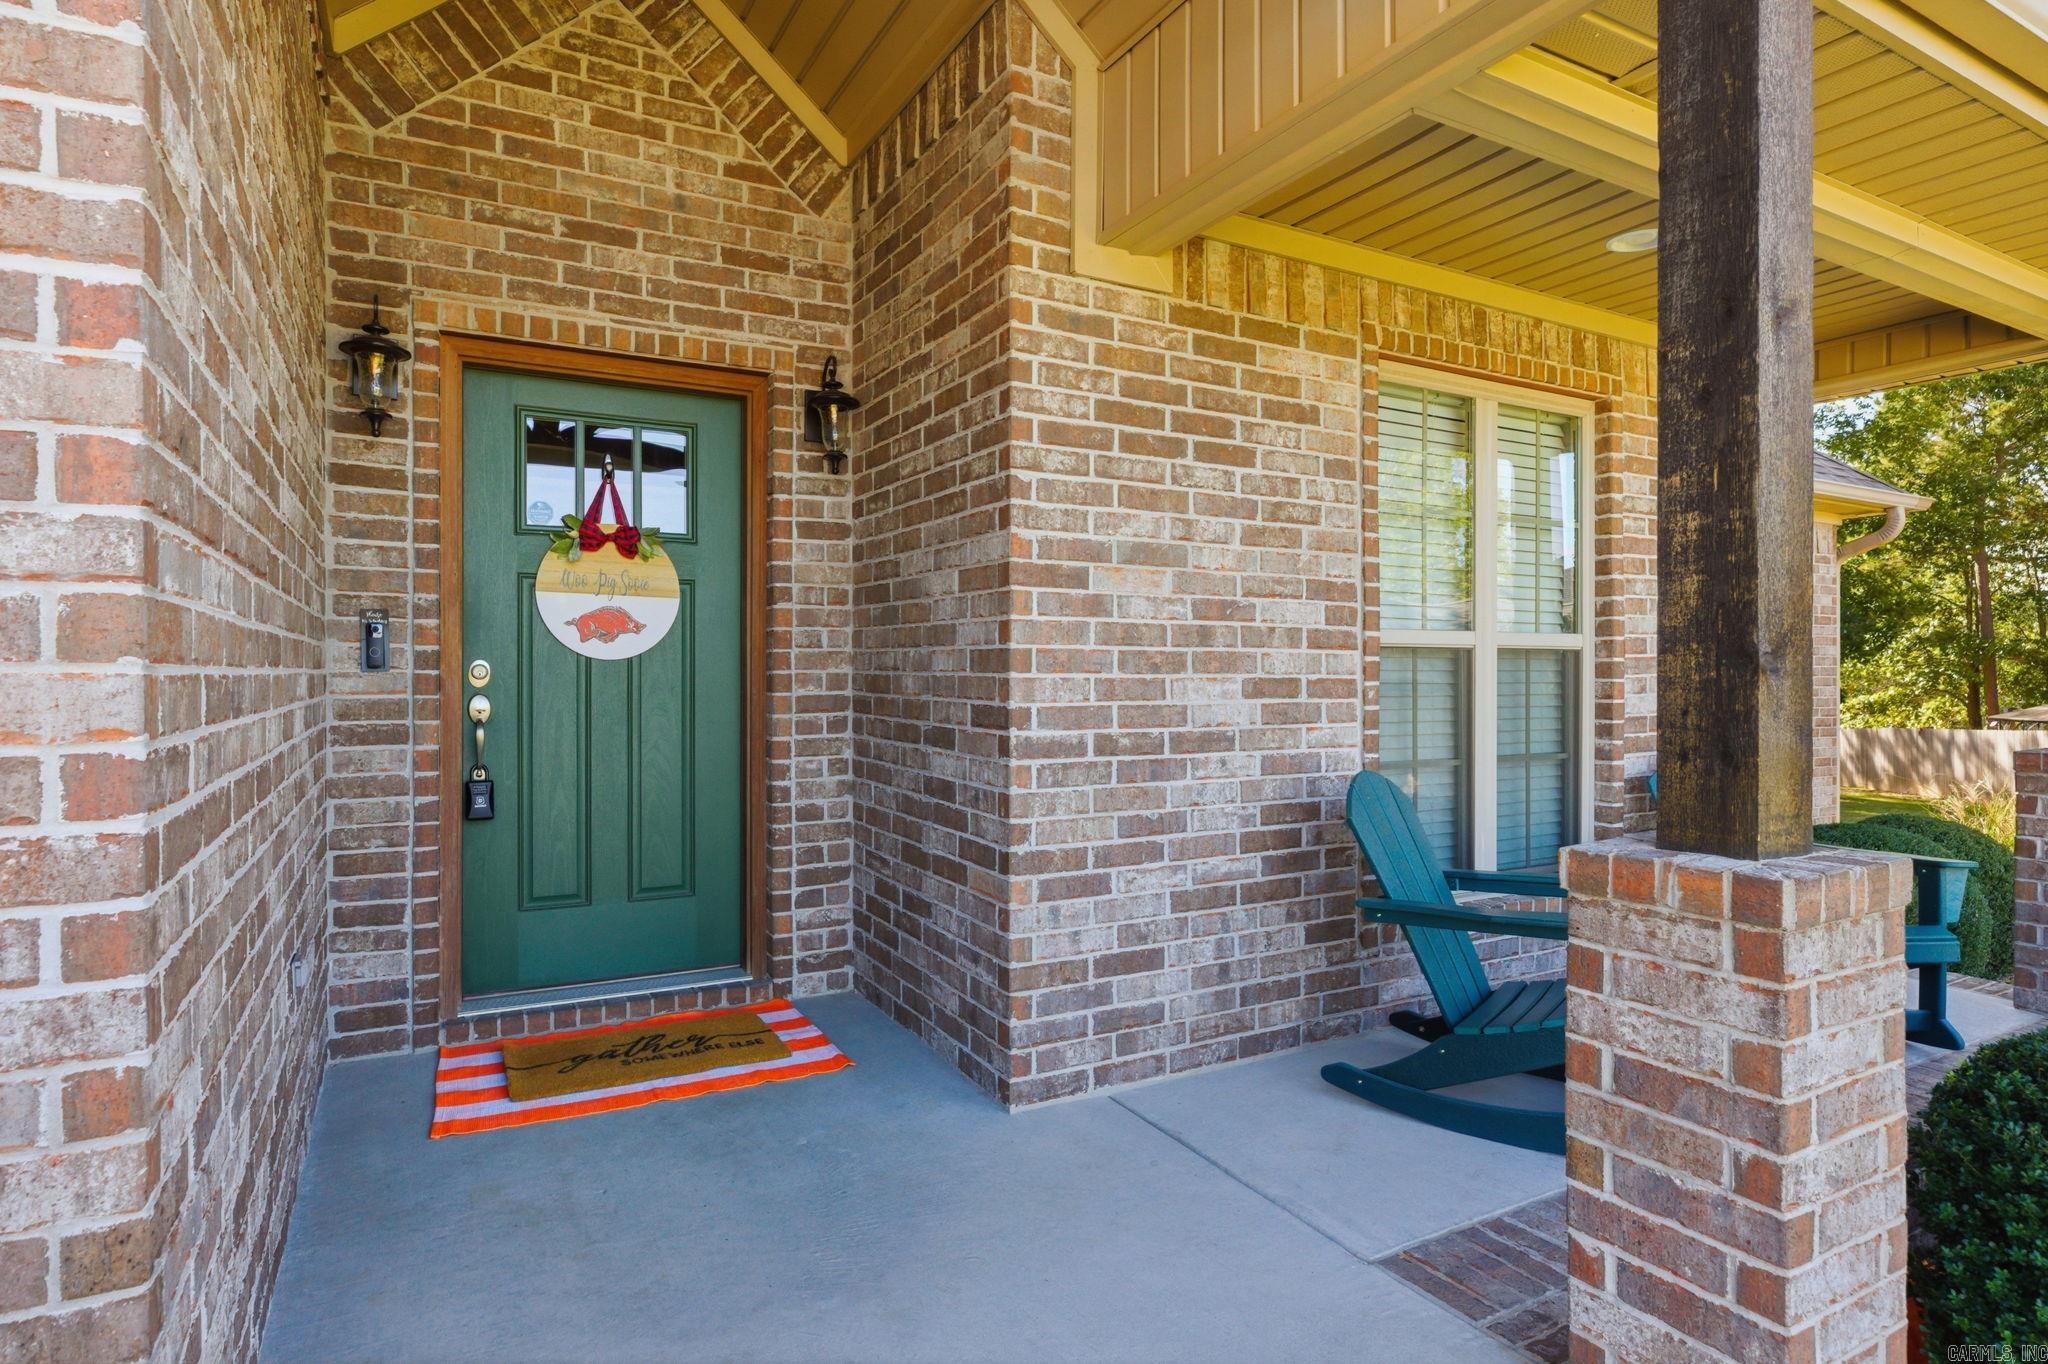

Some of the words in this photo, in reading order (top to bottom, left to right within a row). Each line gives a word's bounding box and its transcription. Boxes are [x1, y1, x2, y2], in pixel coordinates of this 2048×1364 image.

[560, 568, 588, 590] Woo
[593, 569, 617, 601] Pig
[620, 568, 650, 596] Sooie
[557, 1032, 724, 1074] gather
[728, 1037, 766, 1049] ELSE
